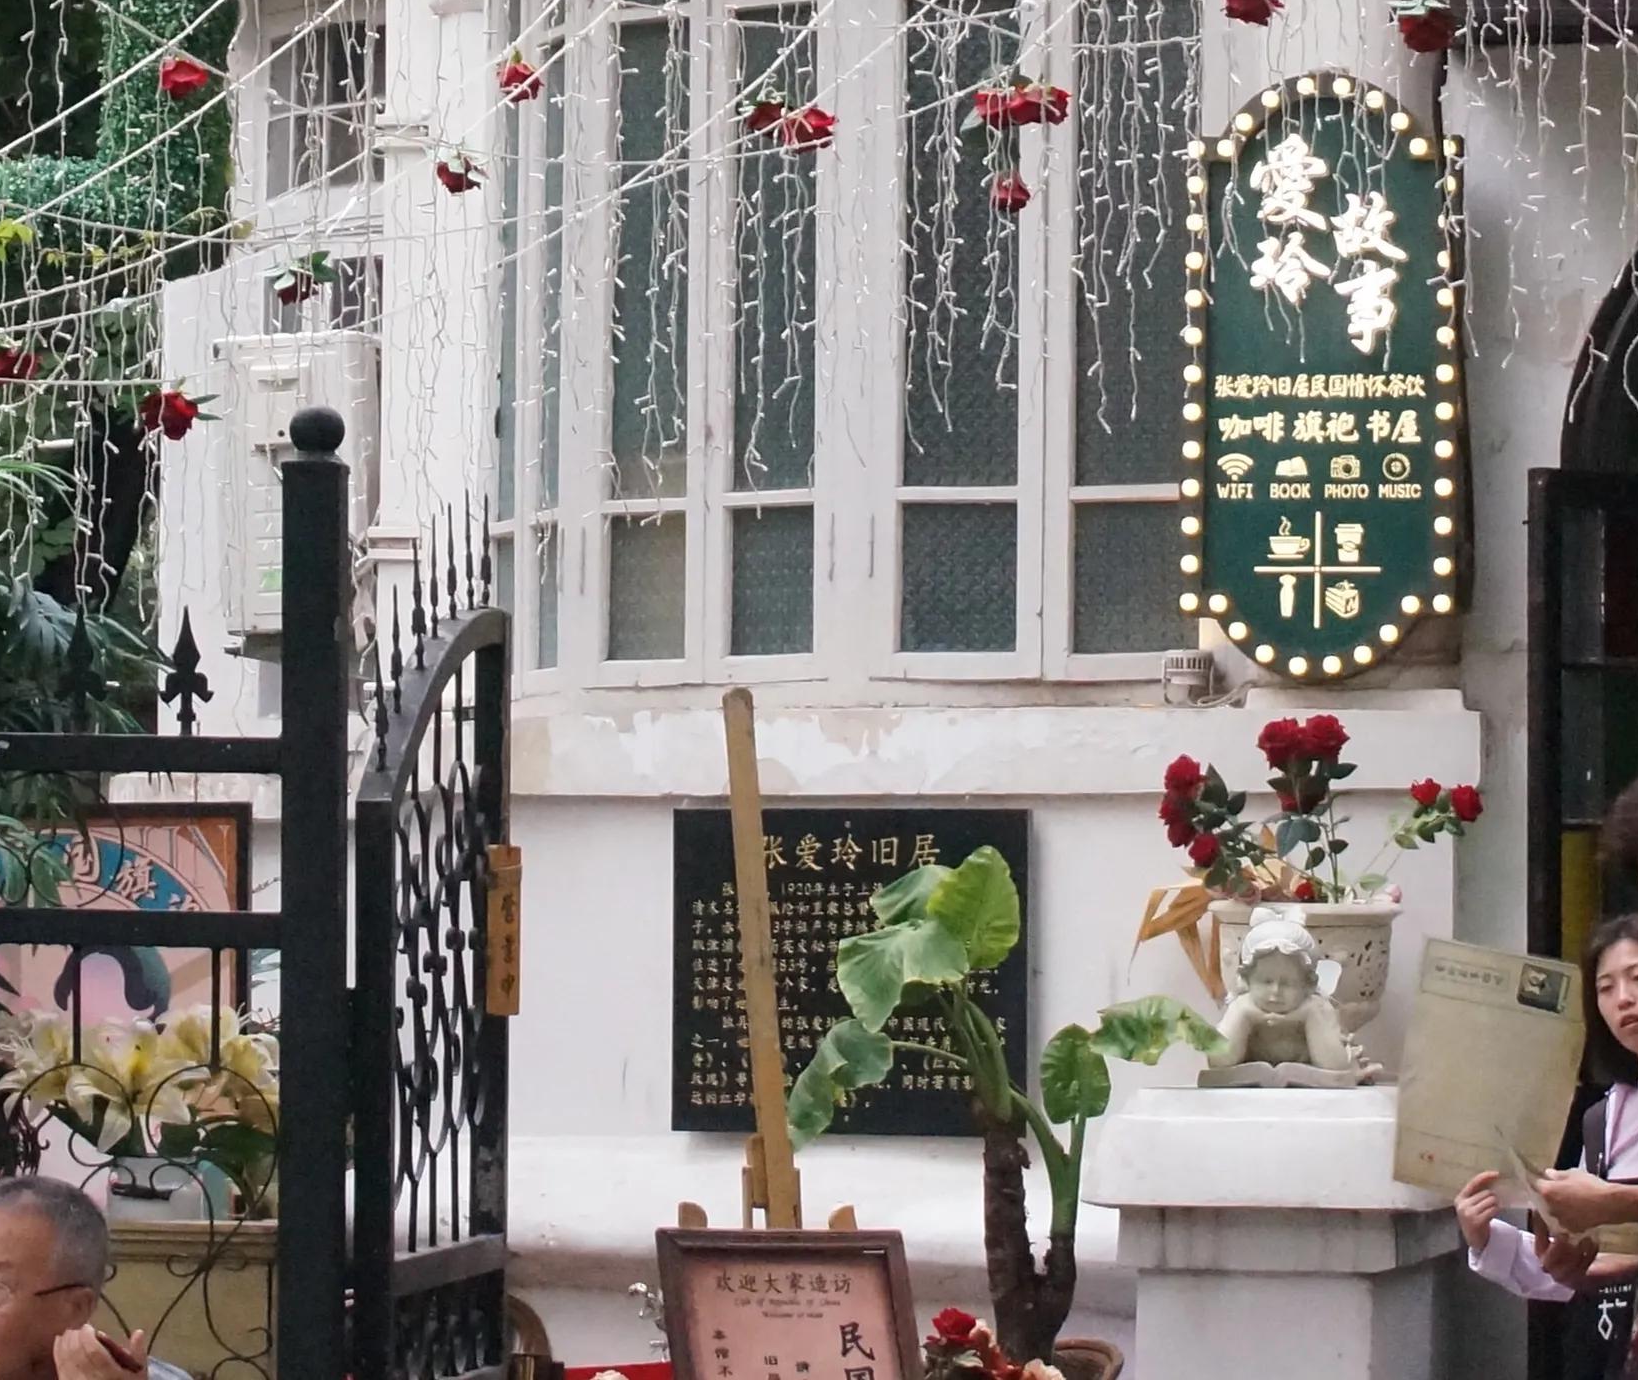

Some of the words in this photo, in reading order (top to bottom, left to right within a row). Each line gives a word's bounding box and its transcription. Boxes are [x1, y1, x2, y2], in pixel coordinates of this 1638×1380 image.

[1218, 413, 1285, 443] 咖啡
[1292, 410, 1359, 443] 旗袍
[1366, 409, 1422, 443] 书屋
[1216, 483, 1255, 500] WIFI
[1269, 483, 1311, 500] BOOK
[1324, 483, 1370, 500] PHOTO
[1378, 483, 1422, 500] MUSIC
[763, 832, 941, 871] 张爱玲旧居
[716, 1272, 852, 1295] 欢迎大家造访
